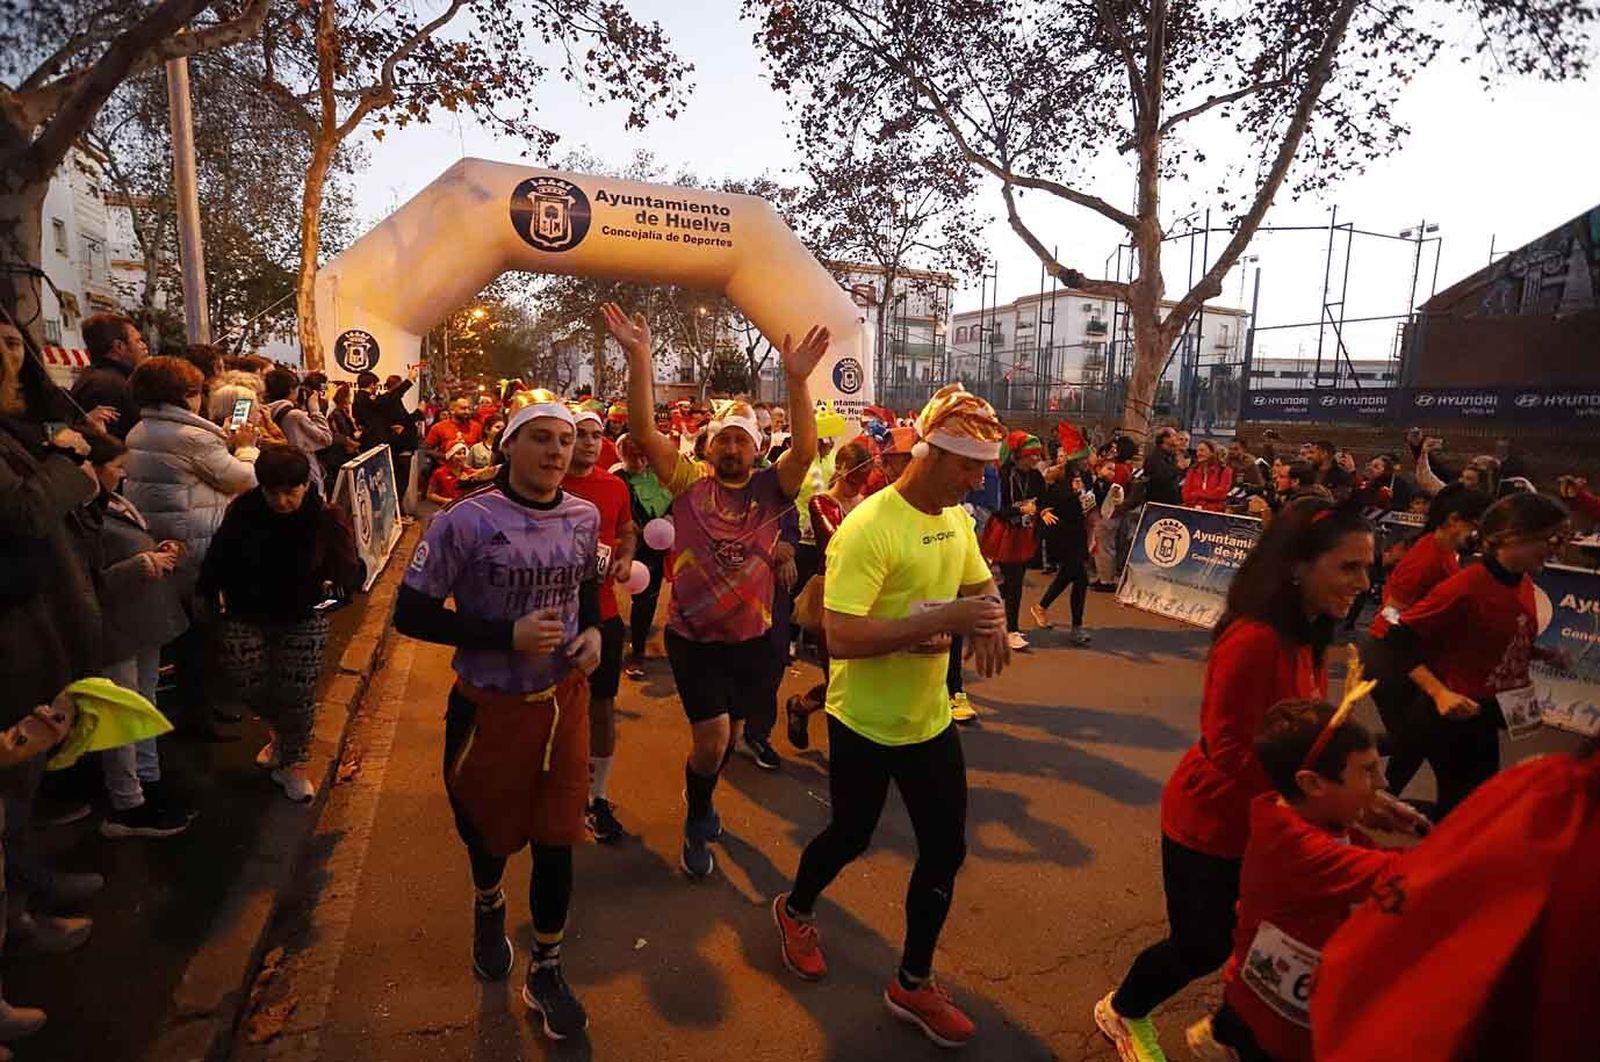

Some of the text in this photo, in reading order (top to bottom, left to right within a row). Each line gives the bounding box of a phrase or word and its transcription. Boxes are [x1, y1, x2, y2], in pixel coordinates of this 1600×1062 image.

[595, 190, 730, 216] Ayuntamiento
[635, 211, 731, 232] de Huelva
[666, 232, 679, 242] de
[683, 234, 733, 248] Deportes
[1268, 397, 1309, 405] HYUNDAI
[1339, 396, 1387, 405] HYUNDAI
[1438, 395, 1498, 405] HYUNDAI
[1214, 545, 1231, 557] de
[489, 563, 584, 587] Emirate
